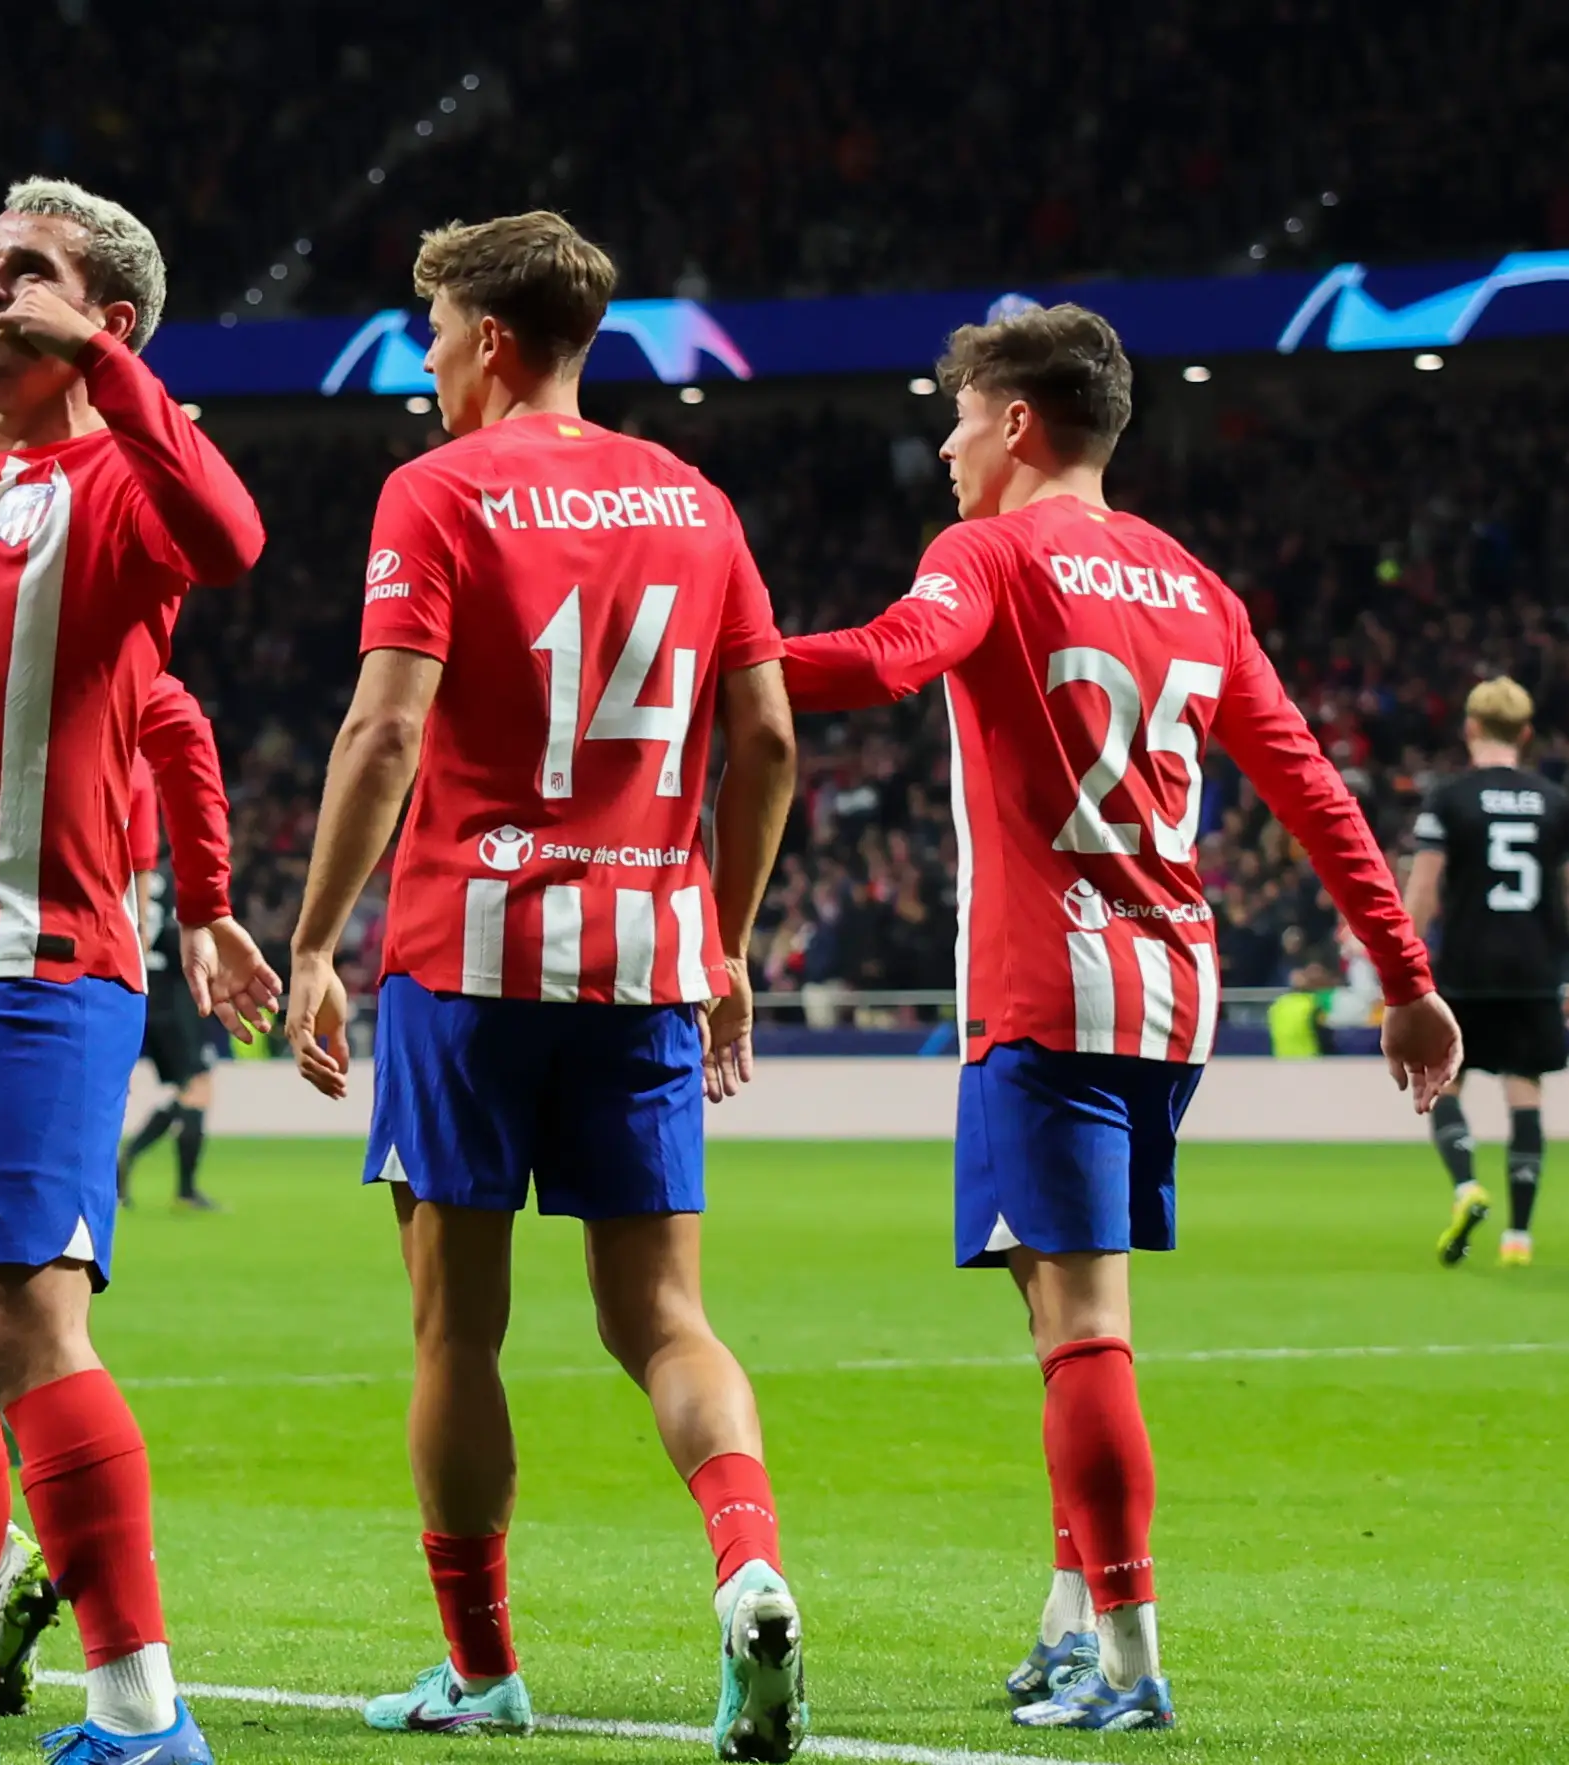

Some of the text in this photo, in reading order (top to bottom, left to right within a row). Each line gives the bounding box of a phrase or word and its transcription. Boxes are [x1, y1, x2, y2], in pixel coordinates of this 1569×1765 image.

[481, 486, 707, 530] M. LLORENTE
[1050, 555, 1208, 615] RIQUELME
[530, 584, 697, 799] 14
[1046, 646, 1224, 864] 25
[539, 843, 592, 863] Save
[592, 844, 618, 866] the
[1487, 820, 1542, 912] 5
[1112, 897, 1165, 919] Save
